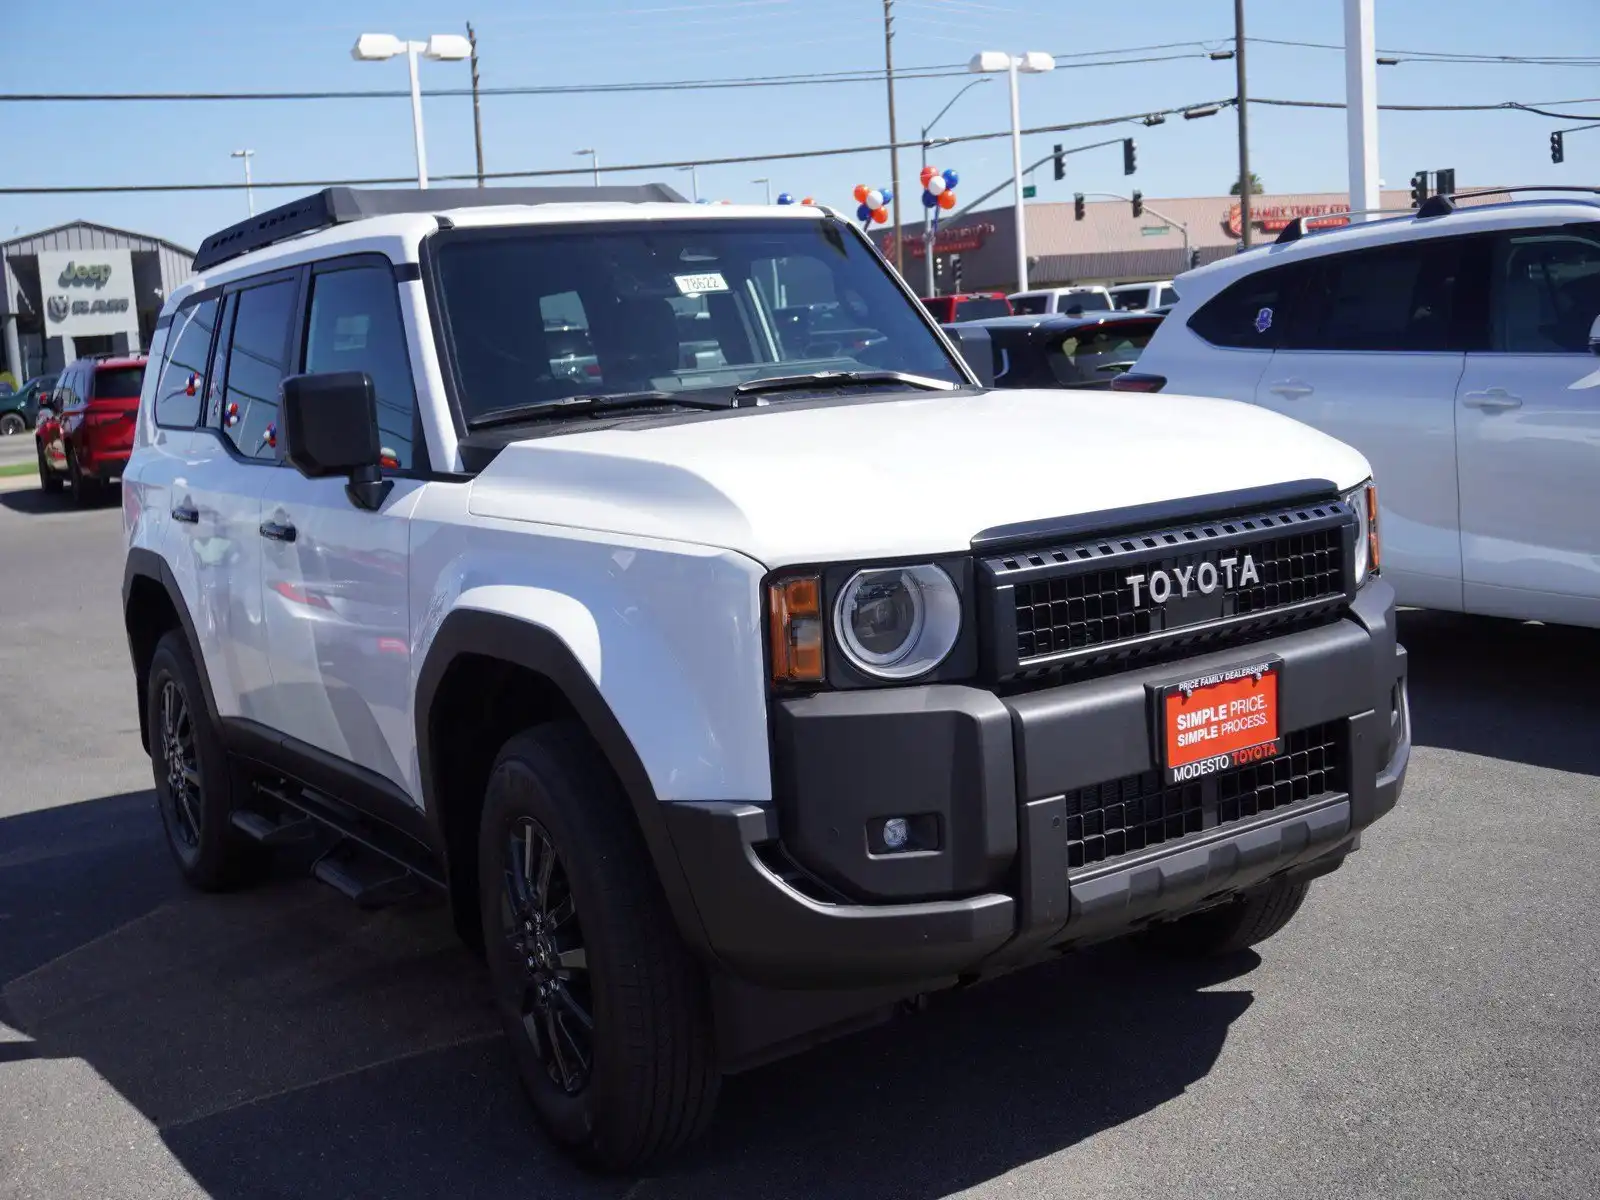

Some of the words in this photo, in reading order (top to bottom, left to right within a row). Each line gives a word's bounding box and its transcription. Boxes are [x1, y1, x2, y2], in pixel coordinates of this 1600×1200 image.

[59, 260, 112, 289] Jeep
[682, 277, 720, 291] 78622
[71, 298, 129, 316] RAM
[1125, 554, 1260, 607] TOYOTA
[1179, 681, 1199, 691] PRICE
[1200, 675, 1224, 687] FAMILY
[1225, 663, 1269, 680] DEALERSHIPS
[1177, 704, 1228, 730] SIMPLE
[1230, 694, 1268, 717] PRICE.
[1177, 725, 1218, 747] SIMPLE
[1221, 712, 1268, 736] PROCESS.
[1174, 755, 1229, 782] MODESTO
[1232, 742, 1277, 766] TOYOTA
